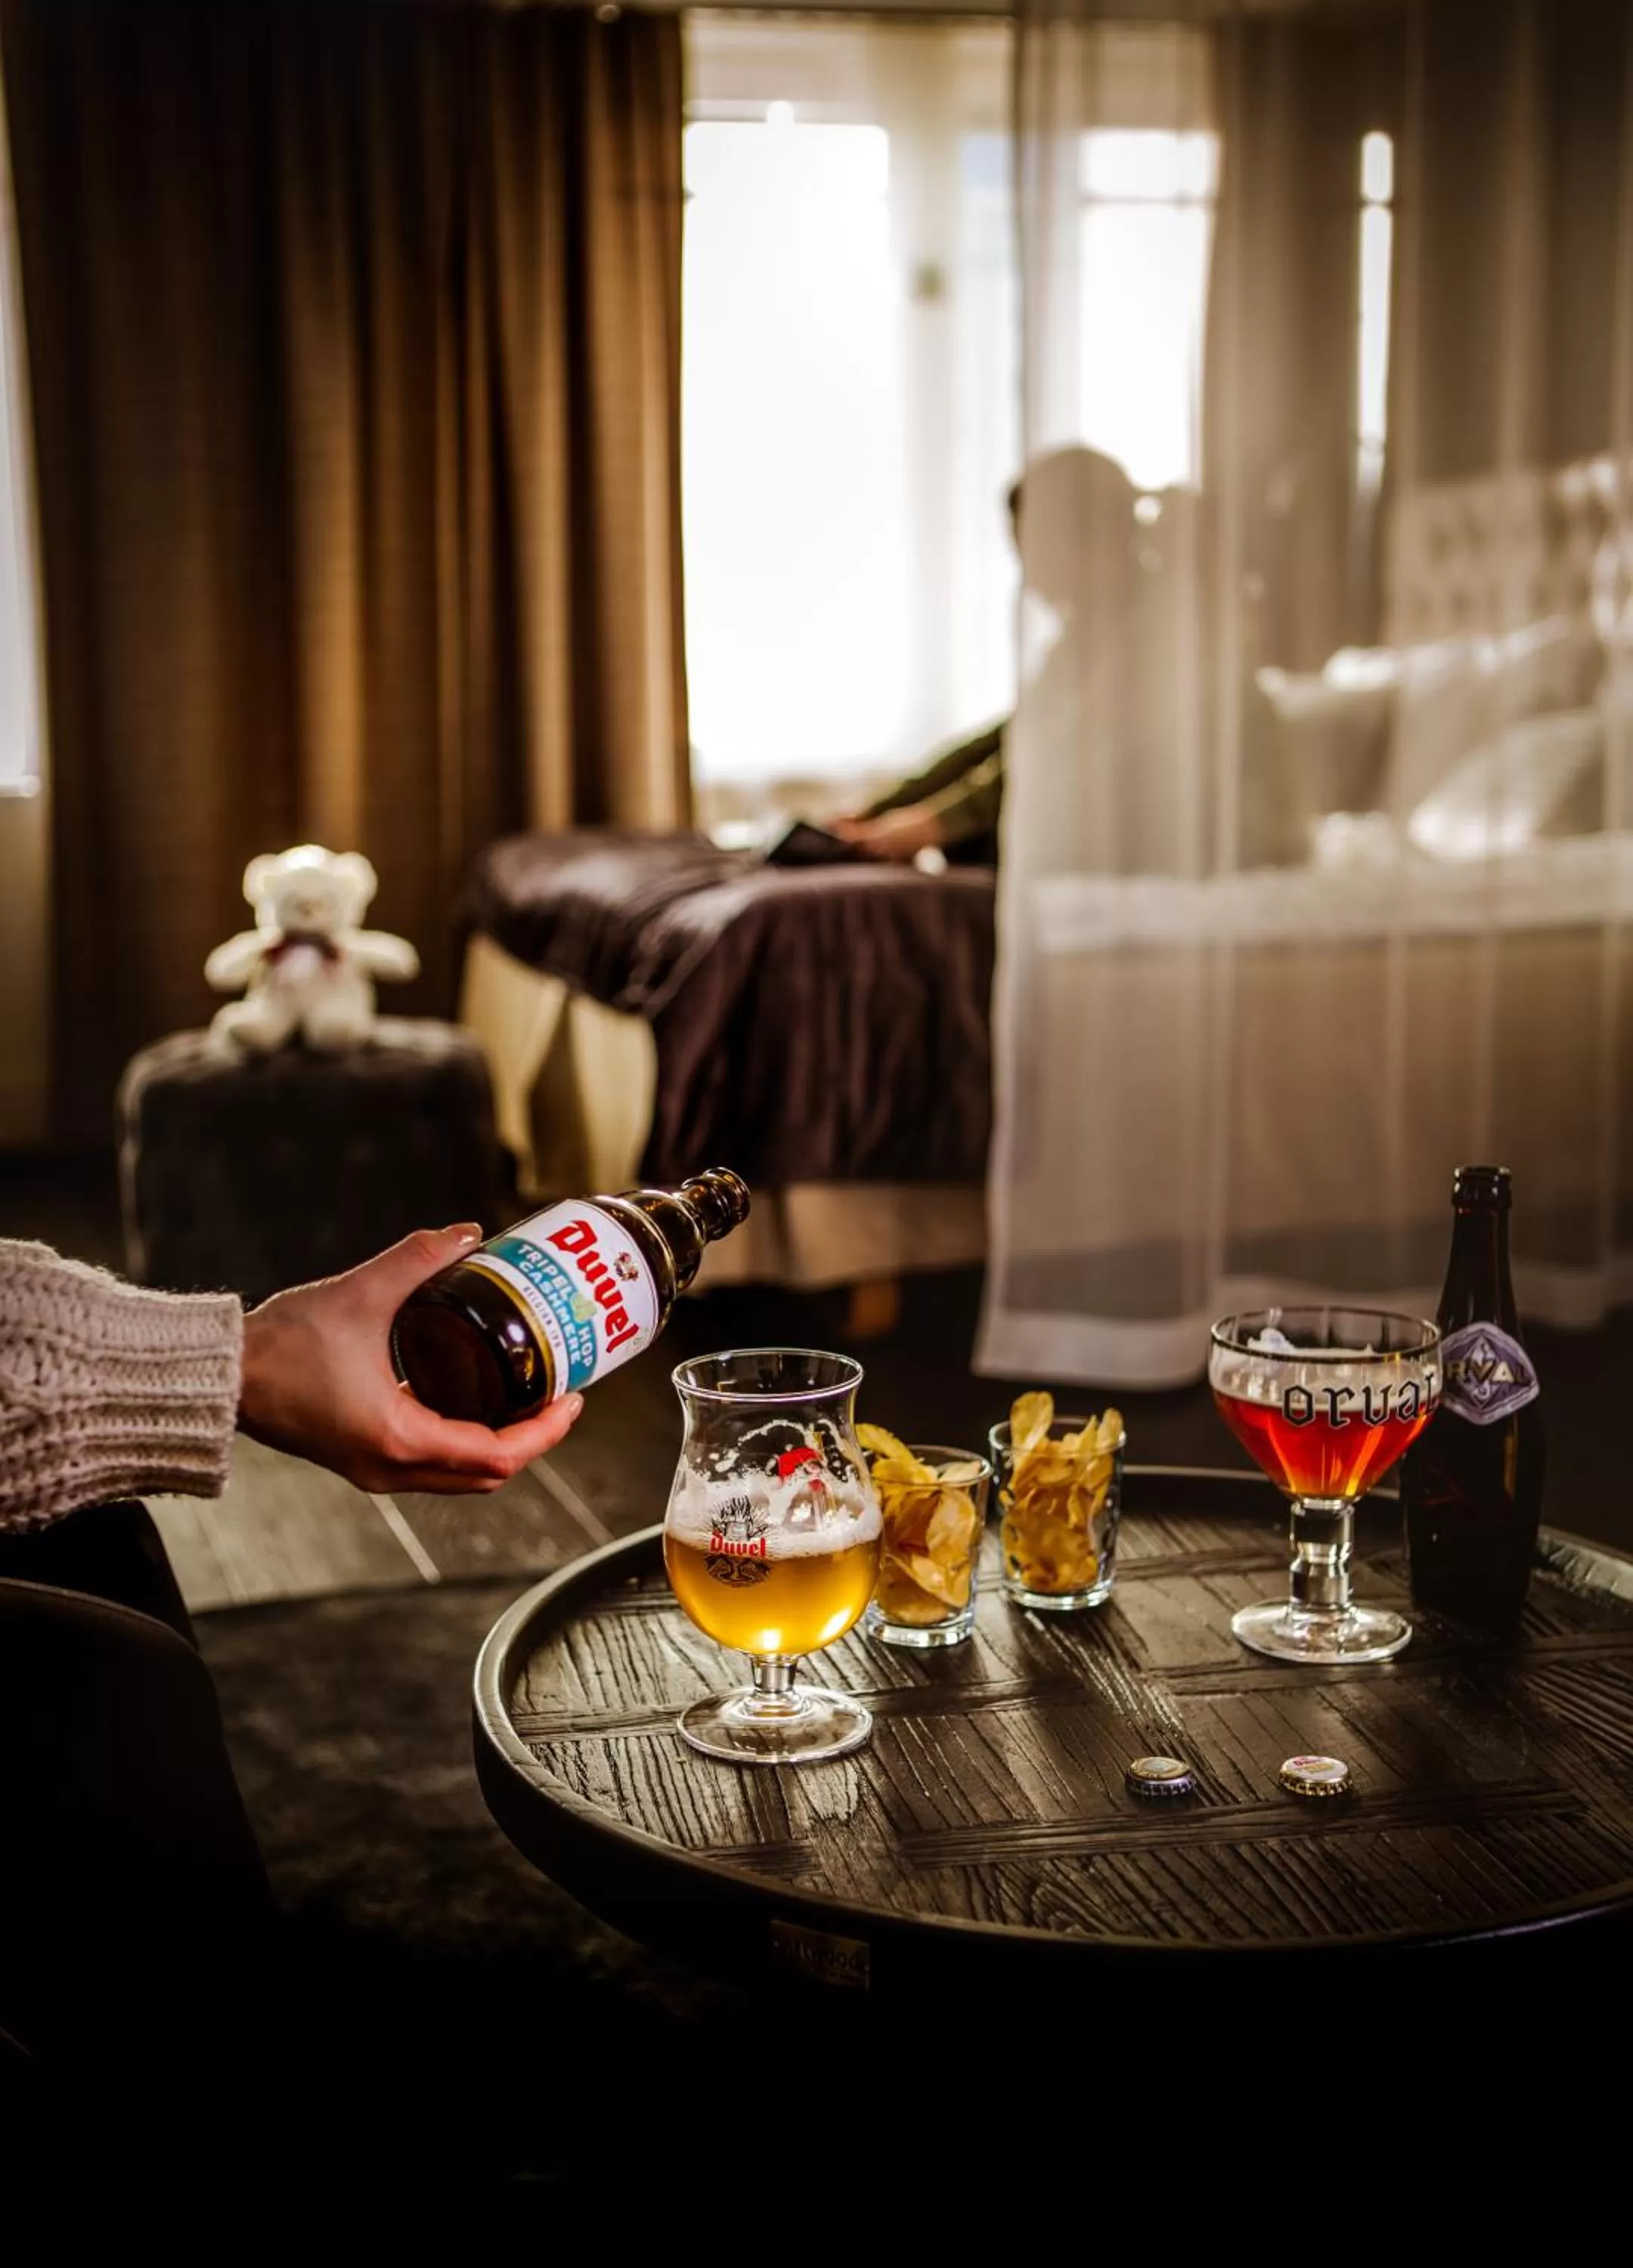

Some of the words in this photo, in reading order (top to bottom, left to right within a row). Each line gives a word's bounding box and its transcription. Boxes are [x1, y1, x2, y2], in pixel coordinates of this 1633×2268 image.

[518, 1244, 572, 1300] TRIPEL
[578, 1325, 593, 1367] HOP
[519, 1258, 581, 1365] CASHMERE
[546, 1220, 639, 1353] Duvel
[1445, 1359, 1530, 1387] RVAL
[711, 1531, 766, 1557] Duvel
